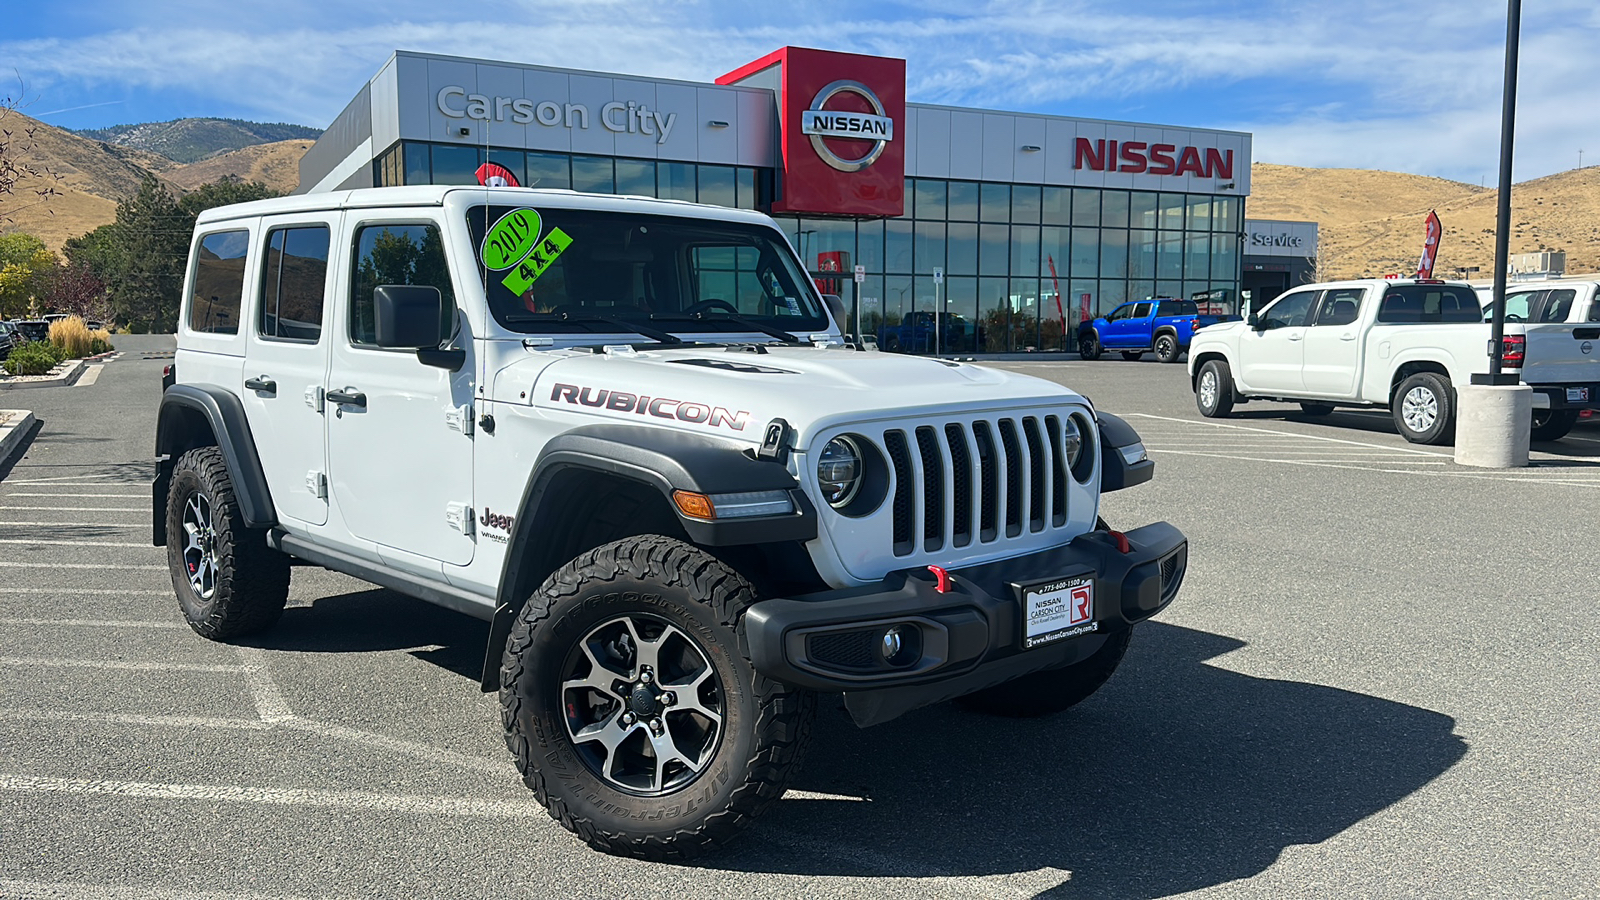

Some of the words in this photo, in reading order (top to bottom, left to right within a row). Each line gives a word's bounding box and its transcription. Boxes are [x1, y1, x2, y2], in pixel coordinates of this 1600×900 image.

[437, 85, 589, 130] Carson
[601, 101, 677, 144] City
[813, 115, 887, 136] NISSAN
[1074, 137, 1234, 180] NISSAN
[490, 212, 531, 264] 2019
[1254, 232, 1303, 248] Service
[549, 382, 751, 432] RUBICON
[479, 506, 515, 535] Jeep
[1030, 607, 1054, 619] CARSON
[1054, 603, 1066, 613] CITY
[1035, 596, 1062, 609] NISSAN
